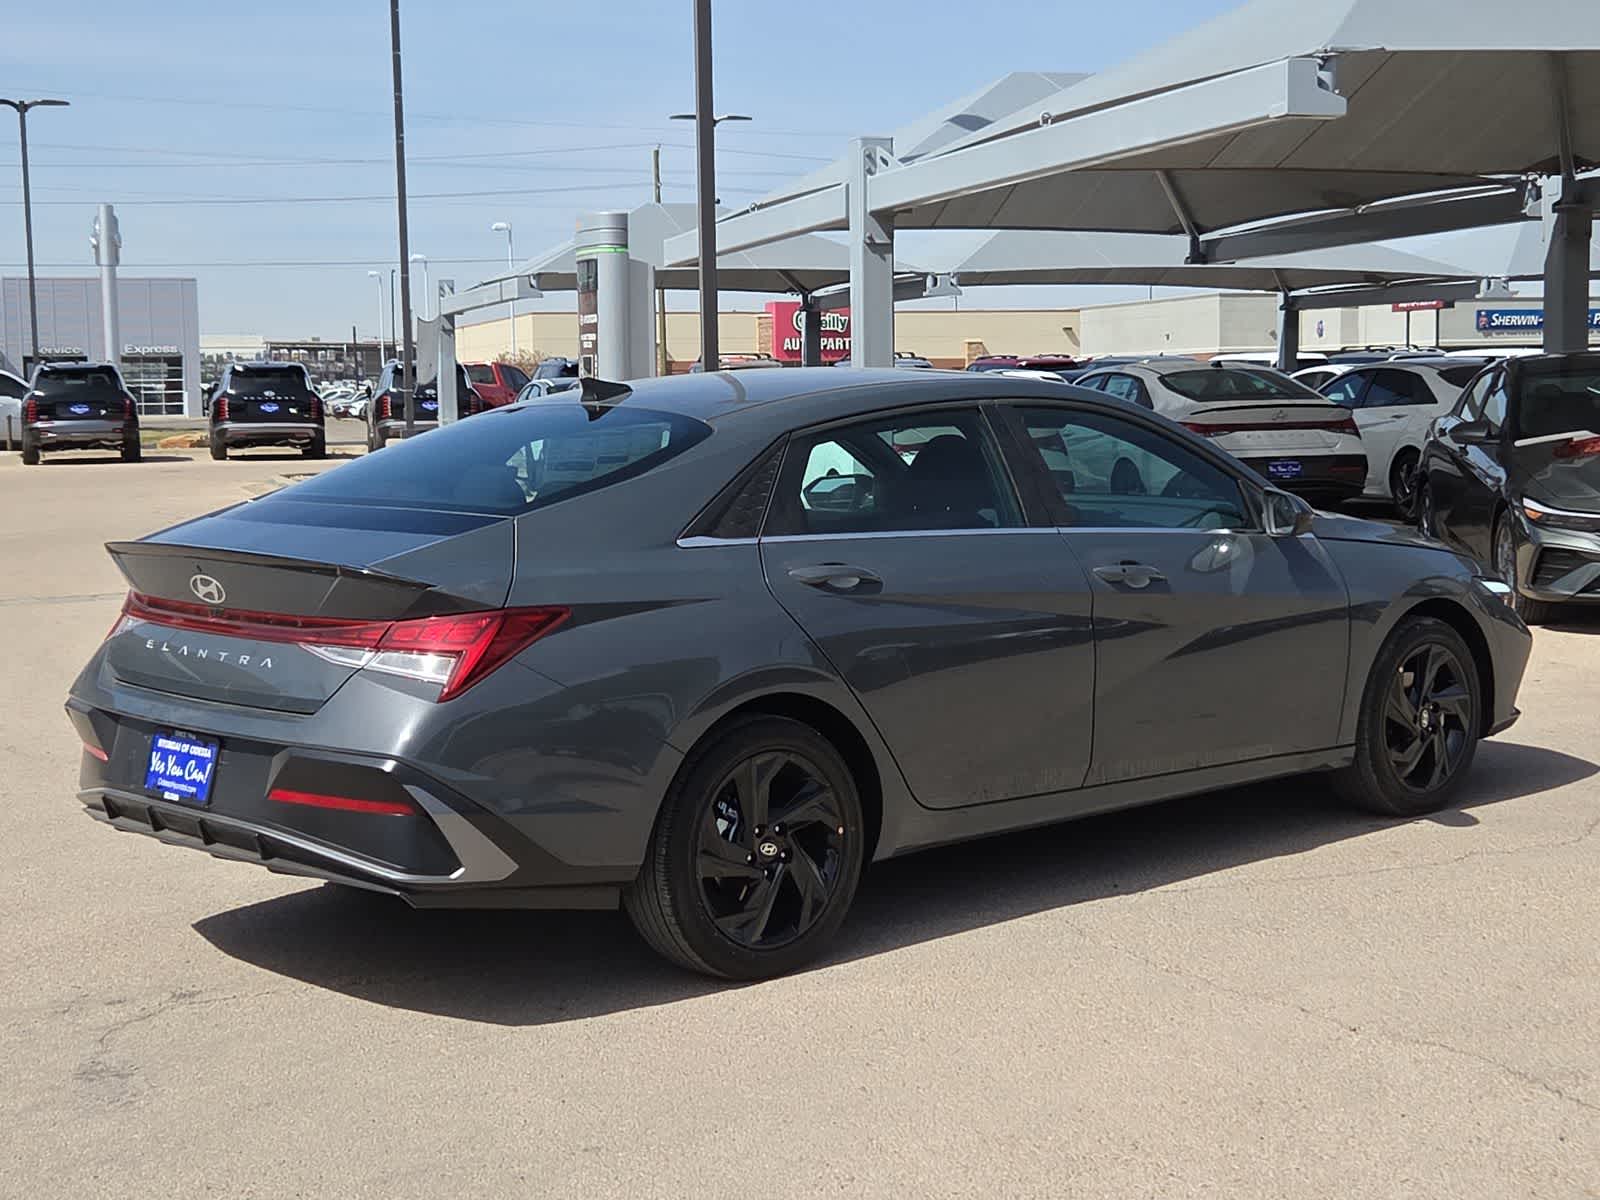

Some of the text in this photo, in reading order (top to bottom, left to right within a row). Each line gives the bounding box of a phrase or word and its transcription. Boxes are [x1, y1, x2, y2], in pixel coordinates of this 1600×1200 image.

[1490, 313, 1543, 326] SHERWIN-
[124, 343, 178, 355] Express
[783, 337, 851, 350] AU PART
[145, 639, 273, 669] ELANTRA
[150, 751, 212, 784] Yes You Can!
